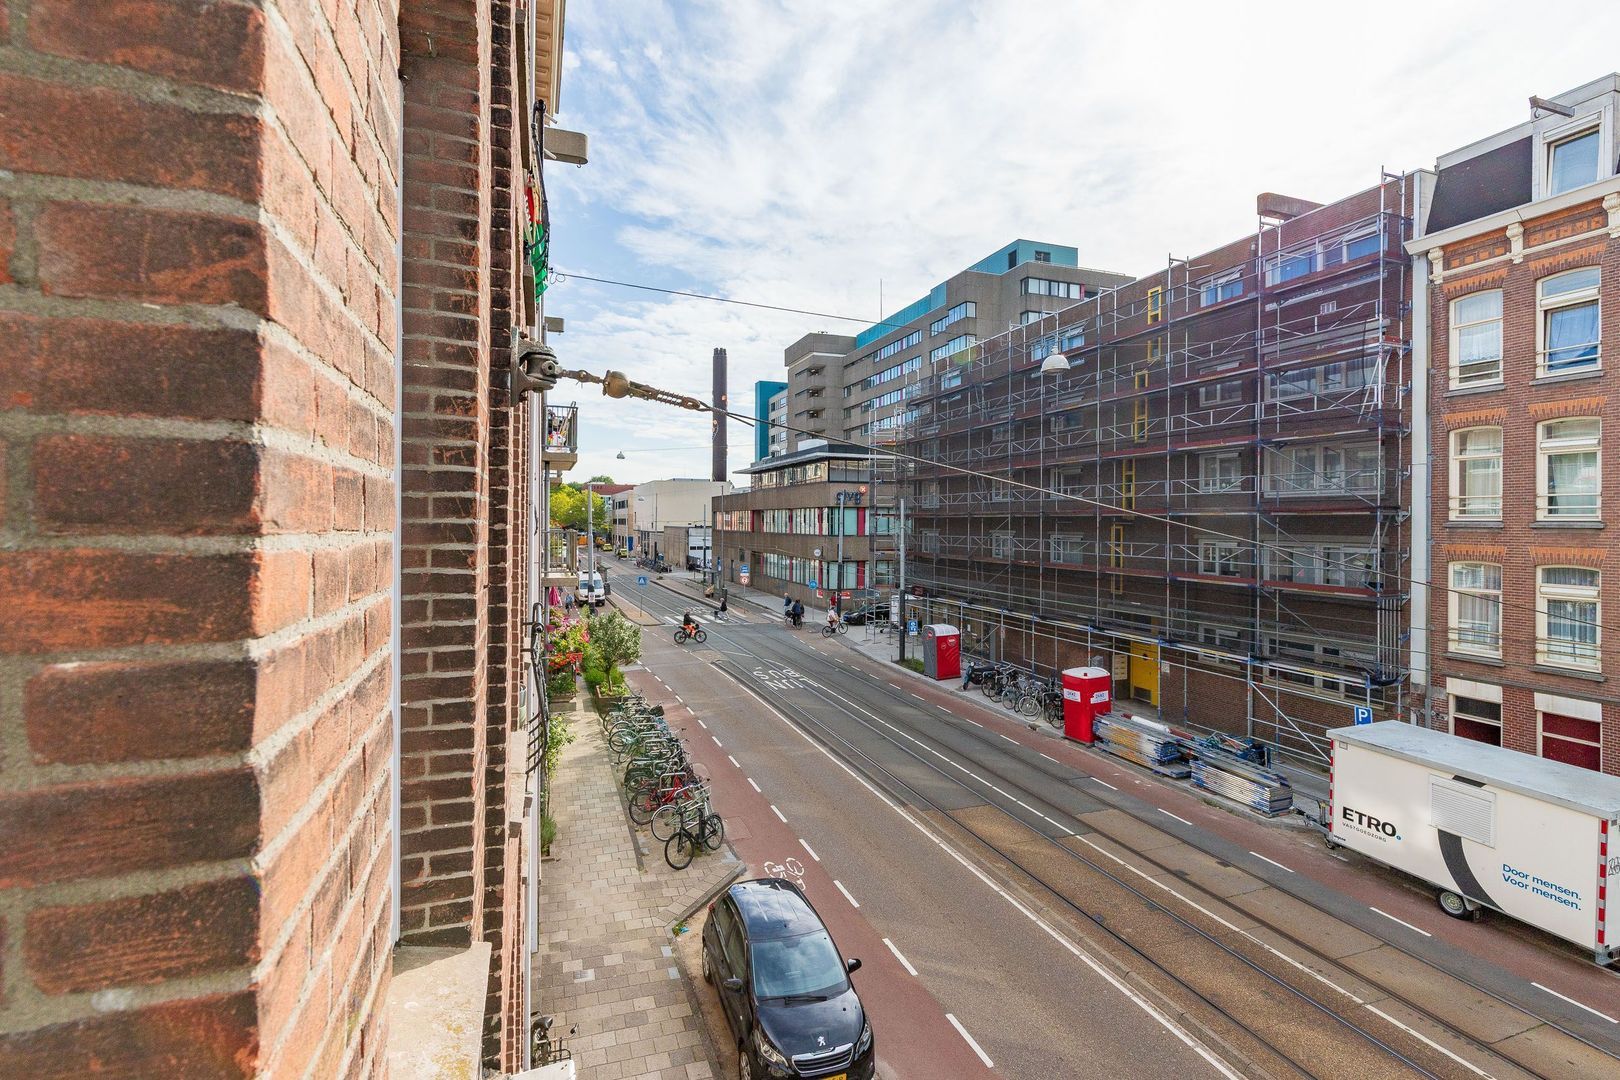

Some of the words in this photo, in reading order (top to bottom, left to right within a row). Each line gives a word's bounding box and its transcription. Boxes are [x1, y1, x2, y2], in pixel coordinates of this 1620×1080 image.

[1358, 708, 1368, 722] P
[1502, 863, 1530, 880] Door
[1532, 876, 1582, 901] mensen.
[1502, 873, 1530, 890] Voor
[1532, 886, 1582, 911] mensen.
